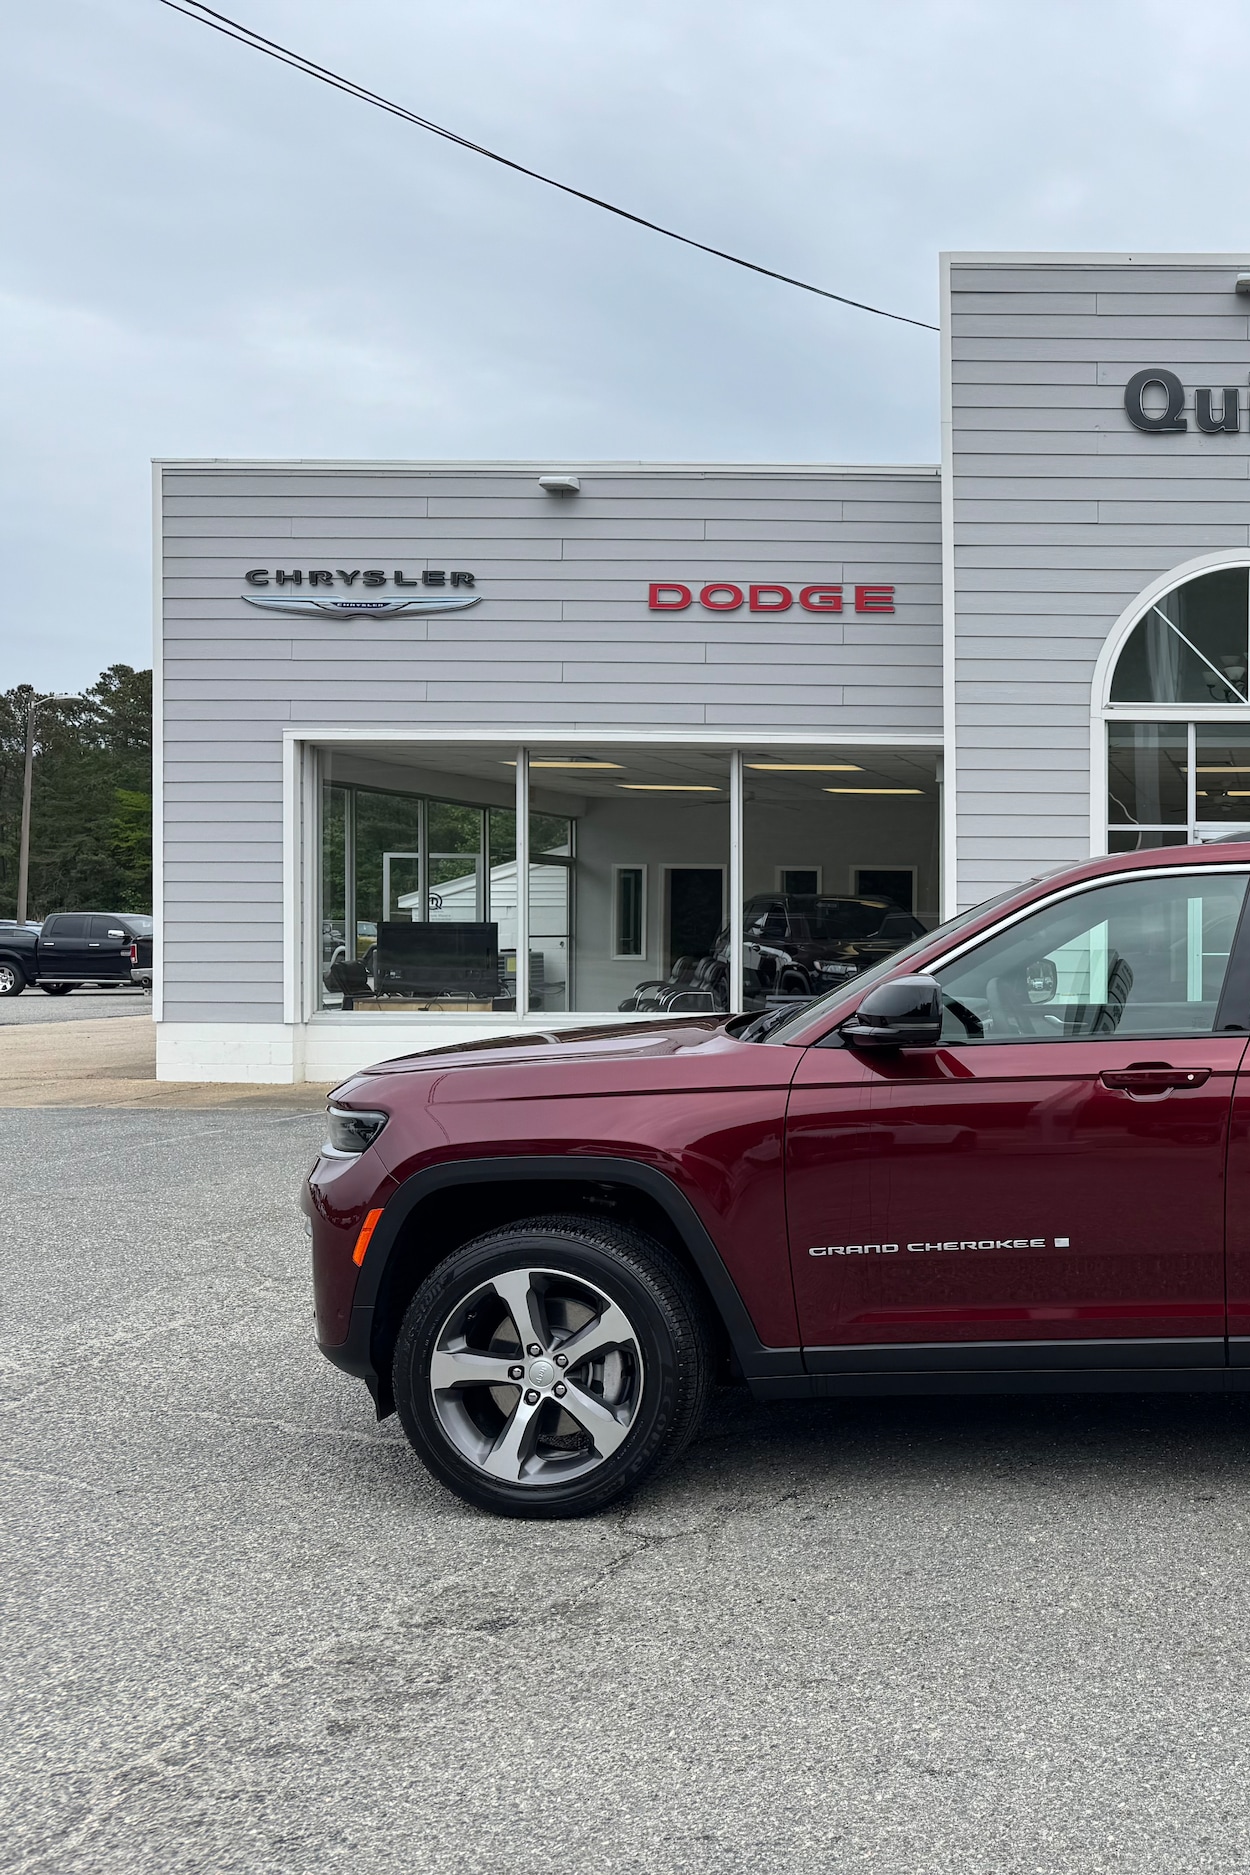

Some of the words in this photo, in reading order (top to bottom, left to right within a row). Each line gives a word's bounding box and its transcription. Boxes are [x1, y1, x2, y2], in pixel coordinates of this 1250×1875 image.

[245, 569, 476, 587] CHRYSLER
[649, 583, 895, 613] DODGE
[808, 1243, 899, 1256] GRAND
[907, 1238, 1046, 1252] CHEROKEE
